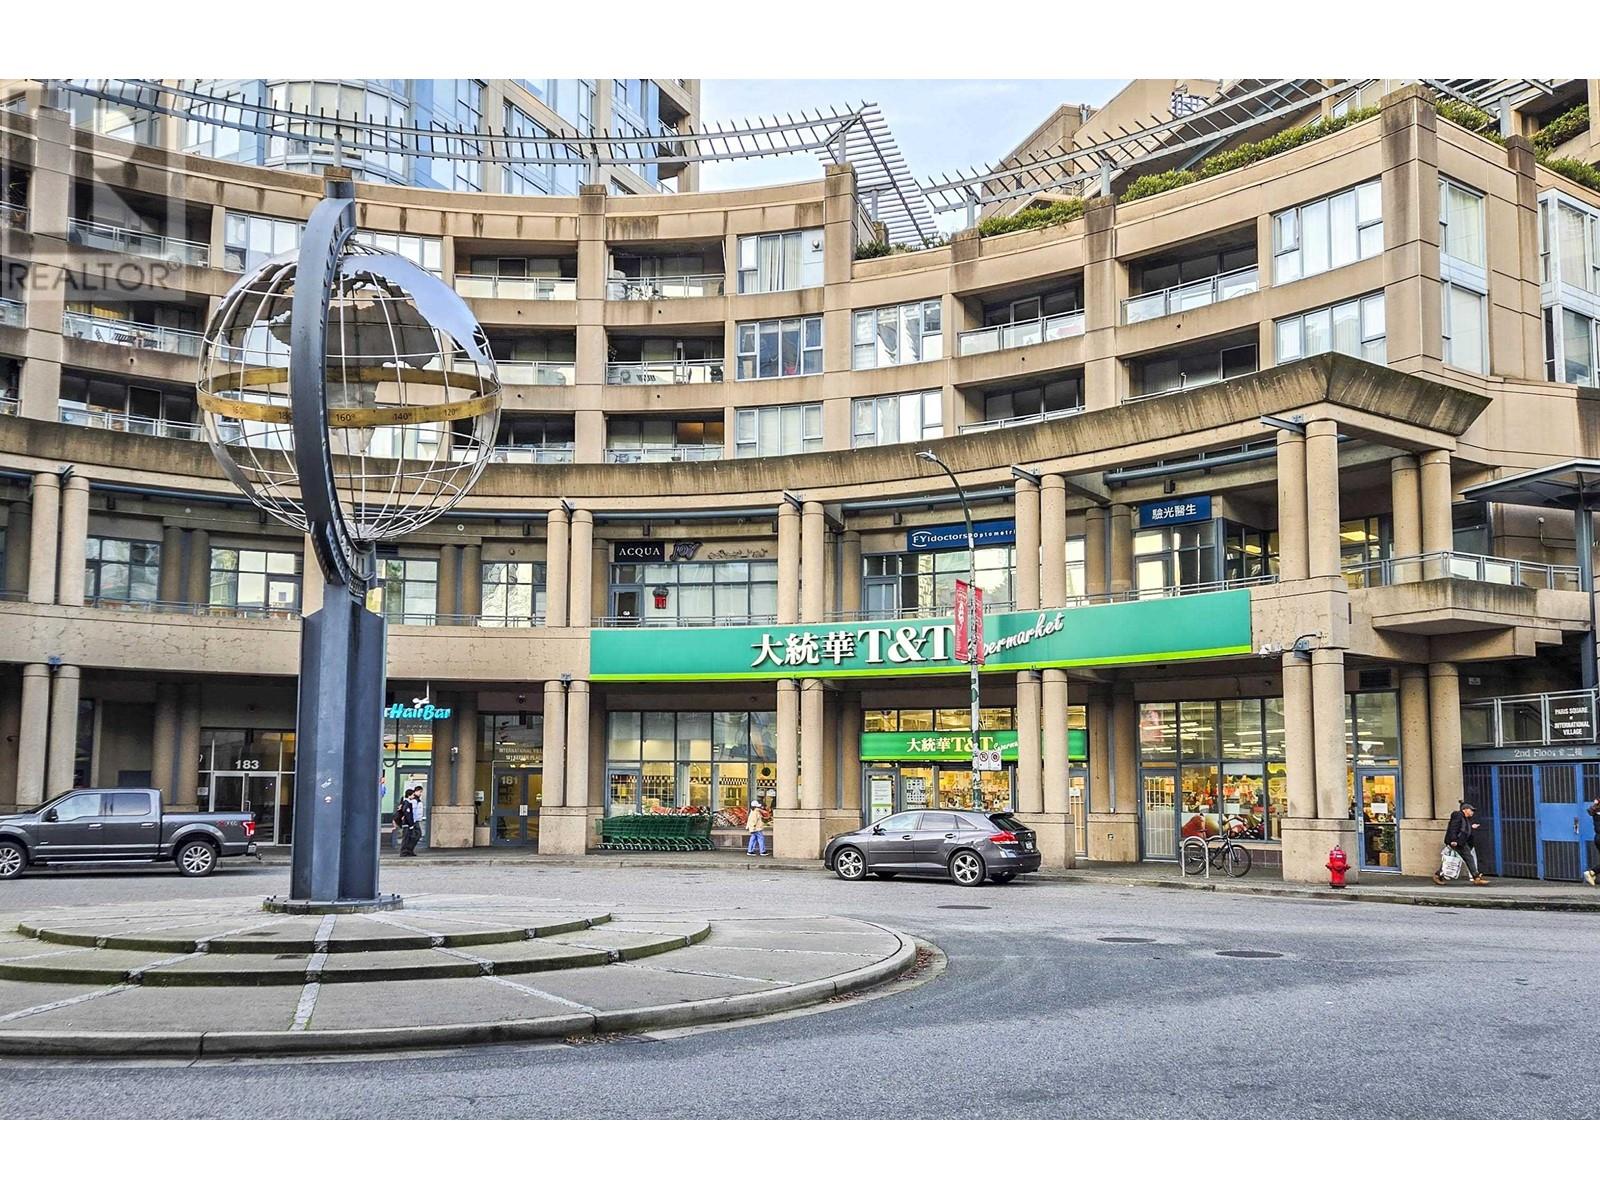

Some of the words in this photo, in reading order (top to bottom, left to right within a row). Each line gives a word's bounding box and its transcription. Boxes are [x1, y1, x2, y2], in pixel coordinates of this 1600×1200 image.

[1152, 504, 1197, 520] 驗光醫生
[618, 547, 660, 558] ACQUA
[751, 631, 855, 667] 大統華
[1569, 706, 1588, 715] SQUARE
[1554, 721, 1591, 729] INTERNATIONAL
[1562, 728, 1583, 736] VILLAGE
[906, 737, 951, 753] 大統華
[1514, 748, 1531, 758] 2nd
[235, 759, 260, 770] 183
[501, 775, 518, 785] 181
